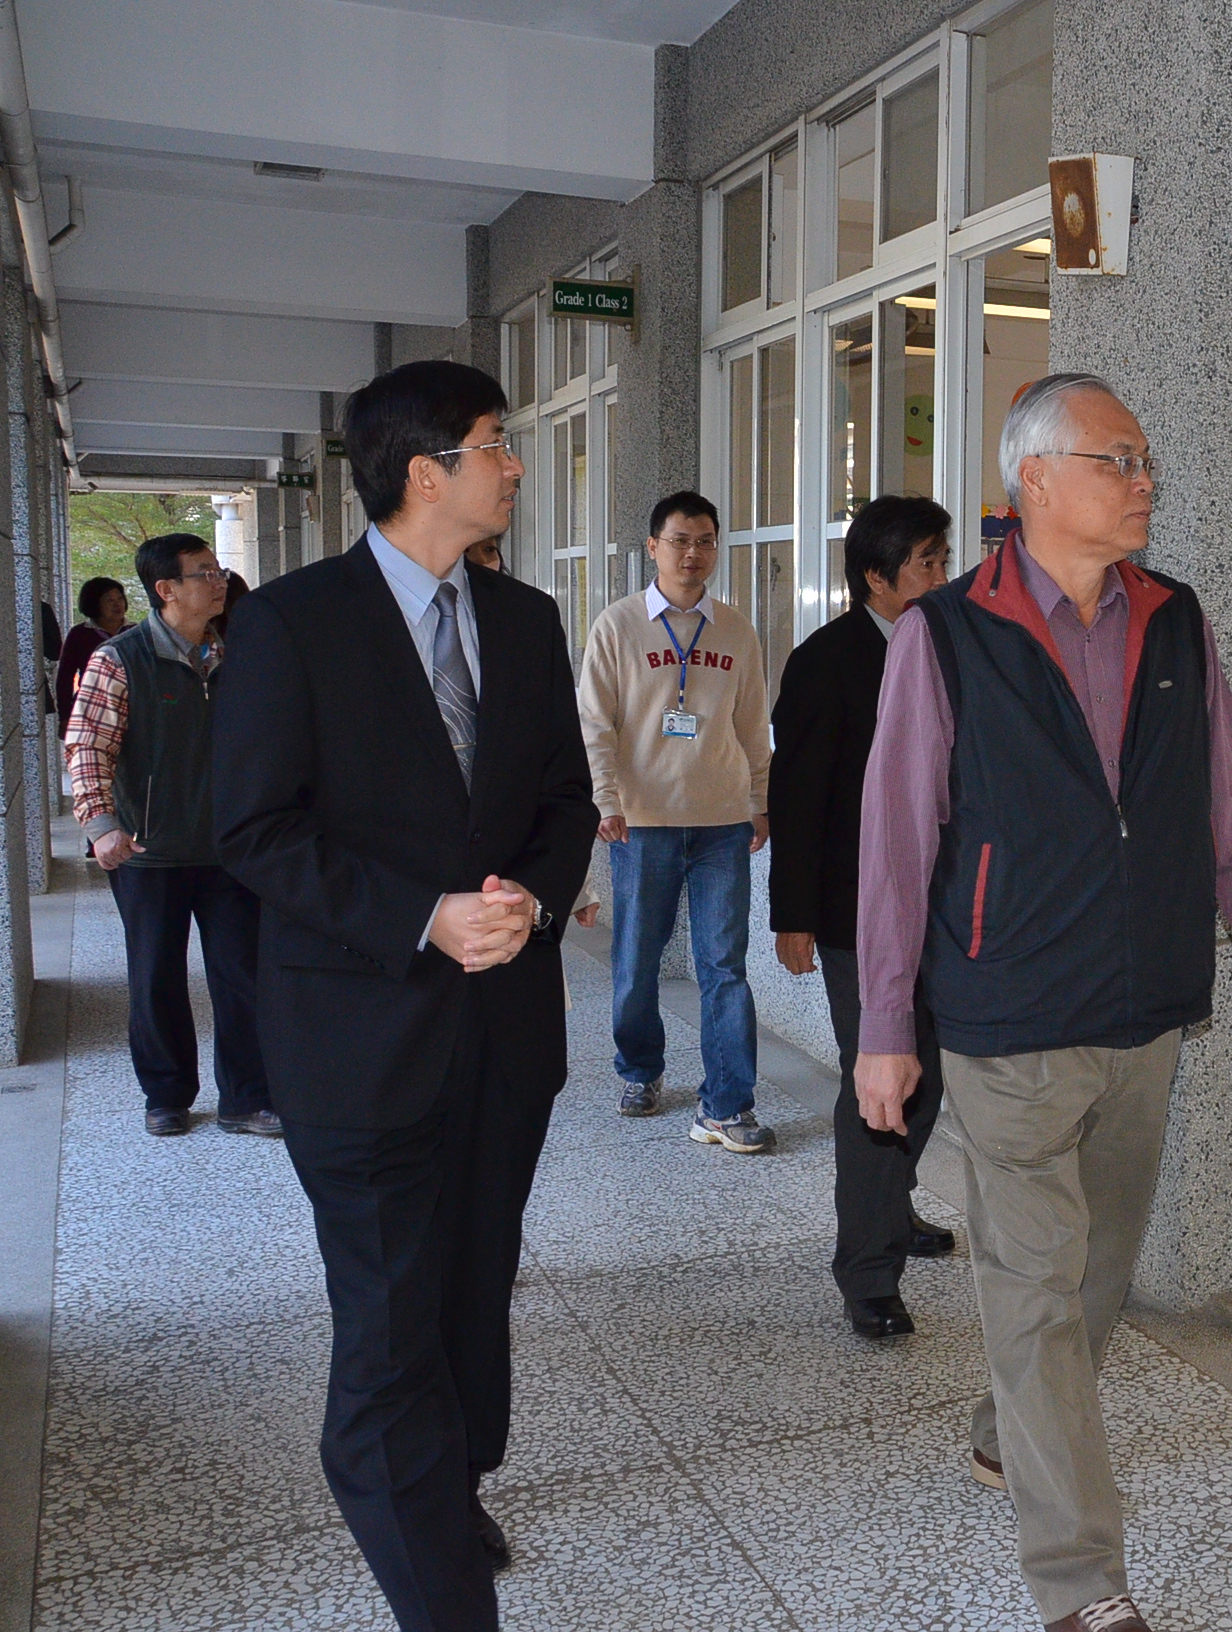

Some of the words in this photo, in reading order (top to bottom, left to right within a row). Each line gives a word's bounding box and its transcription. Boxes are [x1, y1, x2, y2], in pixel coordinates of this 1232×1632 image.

[555, 290, 585, 306] Grade
[588, 294, 592, 307] 1
[595, 294, 620, 309] Class
[622, 296, 628, 310] 2
